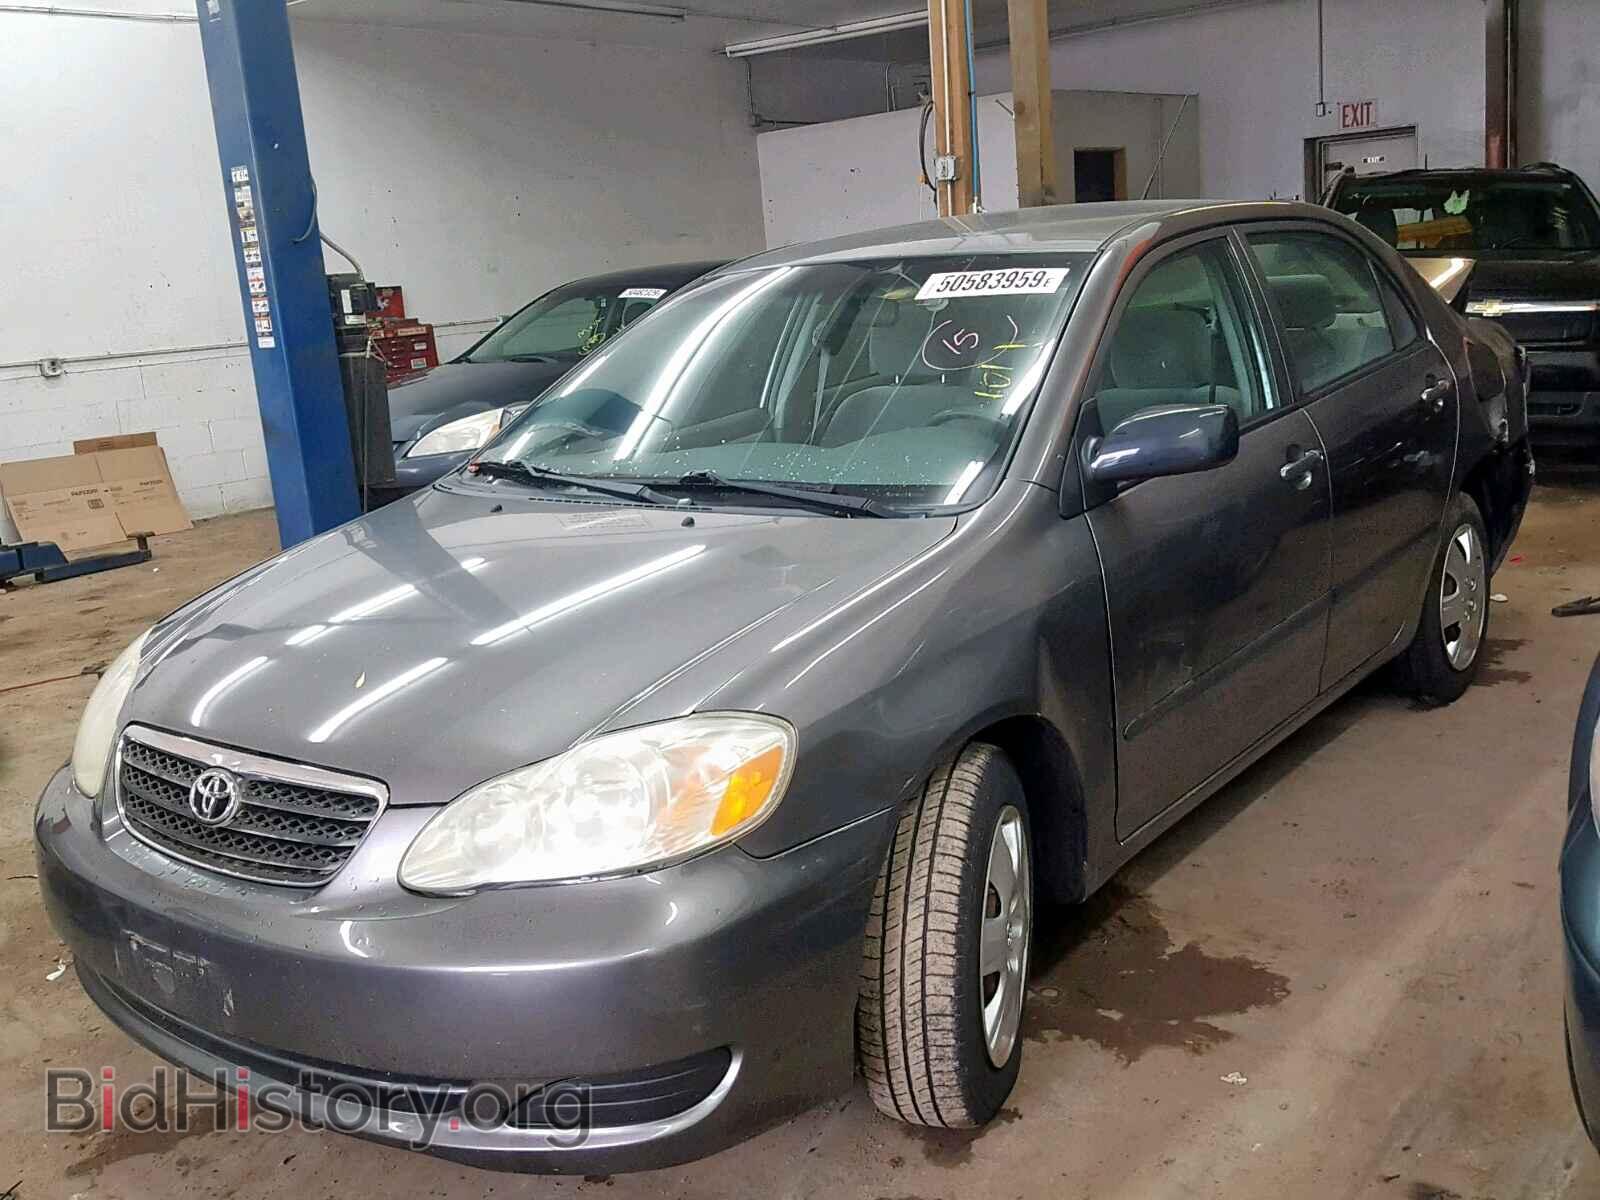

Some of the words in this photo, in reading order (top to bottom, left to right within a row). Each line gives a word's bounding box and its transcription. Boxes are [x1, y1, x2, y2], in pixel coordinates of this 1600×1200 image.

[1342, 102, 1373, 128] EXIT
[936, 270, 1047, 293] 50583959
[942, 328, 980, 355] 15
